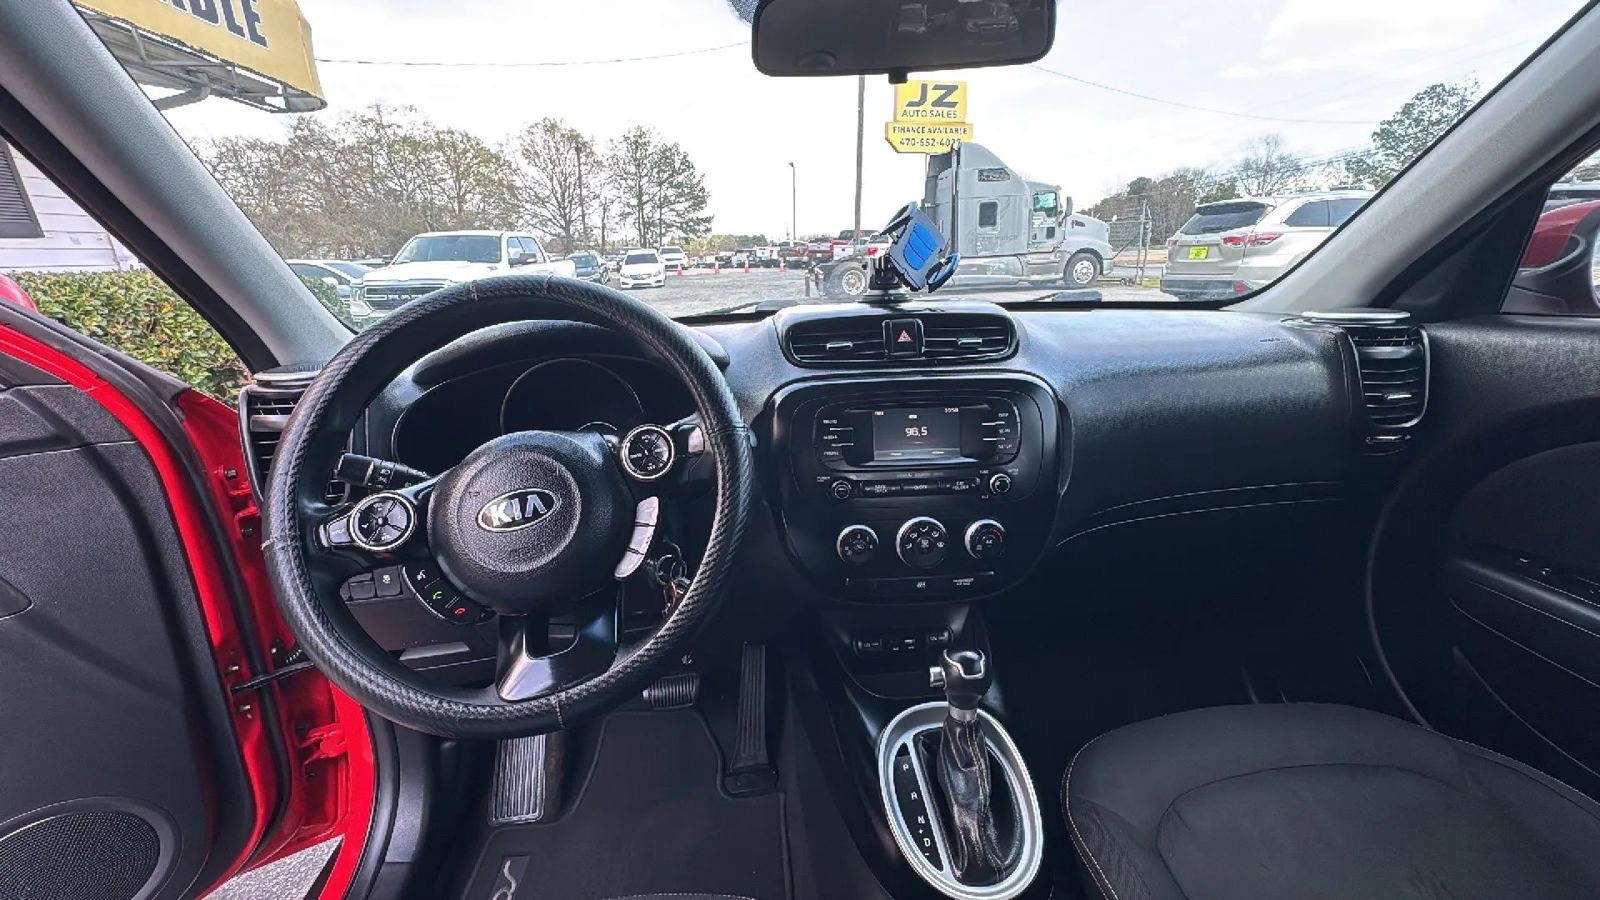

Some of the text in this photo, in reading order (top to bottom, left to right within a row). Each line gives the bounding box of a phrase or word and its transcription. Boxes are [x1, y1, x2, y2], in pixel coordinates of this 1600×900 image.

[905, 83, 959, 108] JZ
[901, 109, 958, 119] AUTO SALES
[892, 126, 968, 135] FINANCE AVAILABLE
[905, 426, 928, 437] 98.5
[489, 494, 548, 527] KIA
[902, 763, 909, 771] P
[923, 837, 931, 847] D
